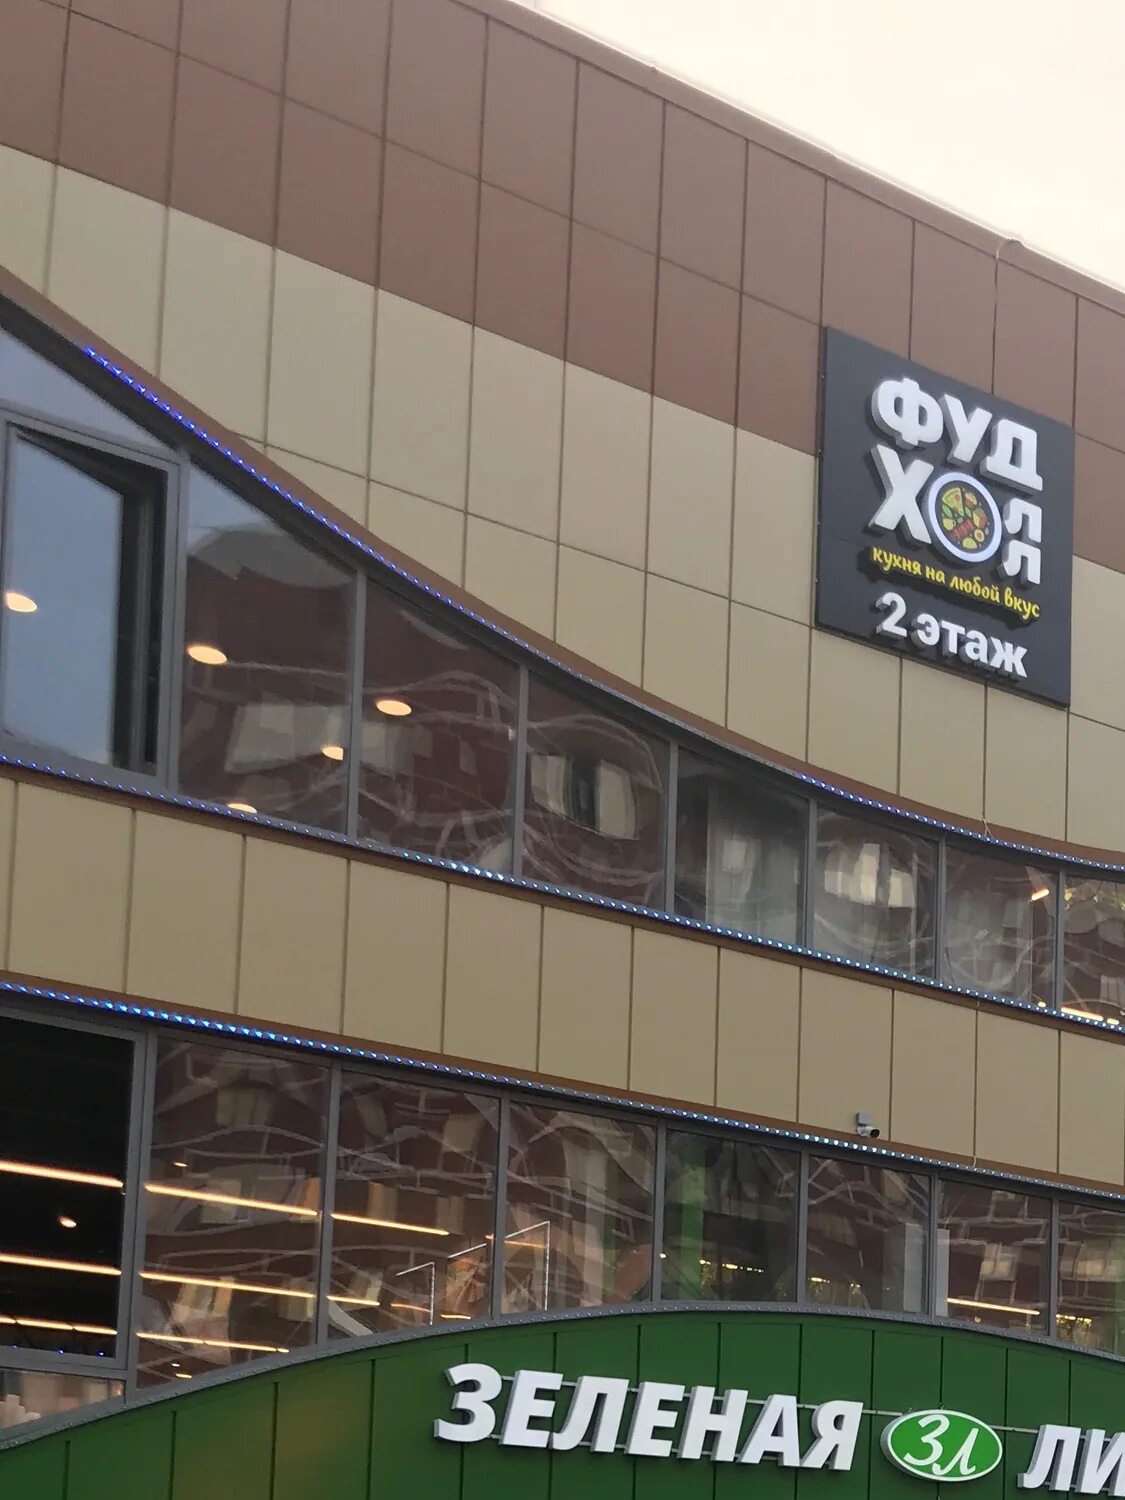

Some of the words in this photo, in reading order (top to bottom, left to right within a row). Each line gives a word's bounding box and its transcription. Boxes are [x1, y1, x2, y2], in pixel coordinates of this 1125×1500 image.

[871, 377, 1043, 491] ФУД
[872, 547, 922, 572] кухня
[925, 566, 946, 584] на
[950, 576, 1000, 603] любой
[1004, 587, 1041, 621] вкус
[876, 592, 908, 638] 2
[912, 613, 1028, 678] этаж
[434, 1363, 863, 1471] ЗЕЛЕНАЯ
